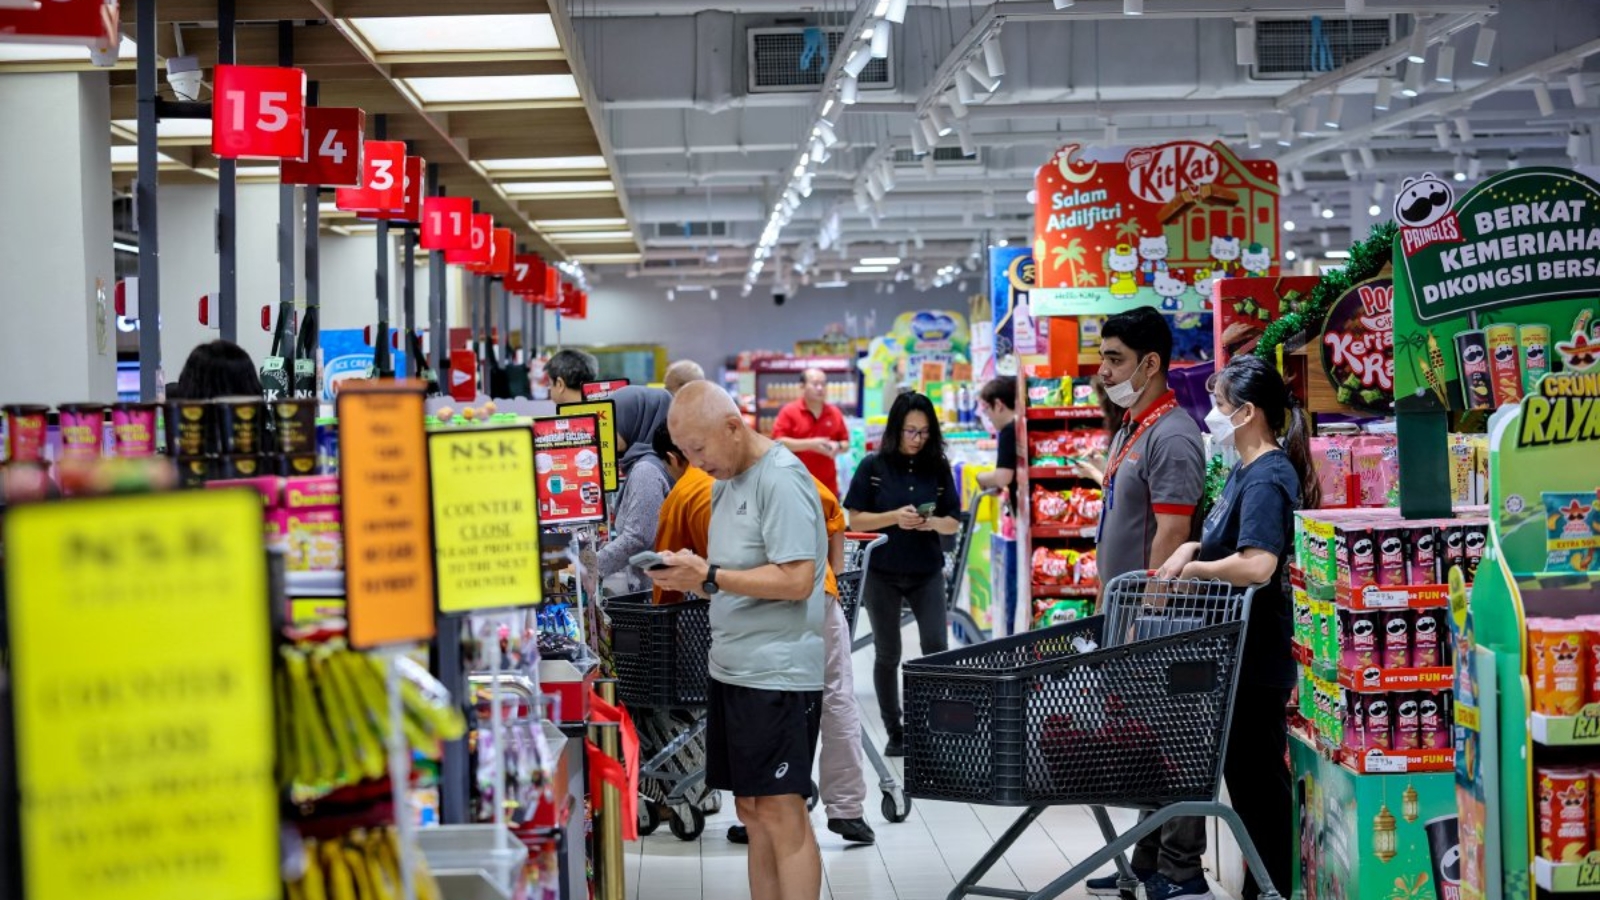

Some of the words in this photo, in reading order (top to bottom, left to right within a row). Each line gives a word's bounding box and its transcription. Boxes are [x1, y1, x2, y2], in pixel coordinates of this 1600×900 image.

[226, 90, 289, 132] 15
[369, 160, 394, 190] 3
[1140, 146, 1215, 201] KitKat
[1052, 188, 1107, 210] Salam
[430, 211, 462, 235] 11
[1045, 202, 1121, 233] Aidilfitri
[1474, 200, 1586, 235] BERKAT
[472, 227, 485, 249] 0
[1403, 215, 1459, 253] PRINGLES
[1440, 228, 1600, 273] KEMERIAHA
[514, 263, 529, 281] 7
[1422, 263, 1532, 304] DIKONGSI
[350, 359, 374, 368] CREA
[1325, 331, 1394, 374] Keria
[1362, 353, 1394, 389] Ra
[1545, 373, 1600, 397] CRUN
[451, 440, 518, 460] NSK
[443, 500, 523, 517] COUNTER
[460, 523, 513, 541] CLOSE
[1418, 592, 1440, 600] FUN
[1419, 673, 1440, 681] FUN
[1423, 755, 1444, 764] FUN
[1577, 864, 1600, 887] RA
